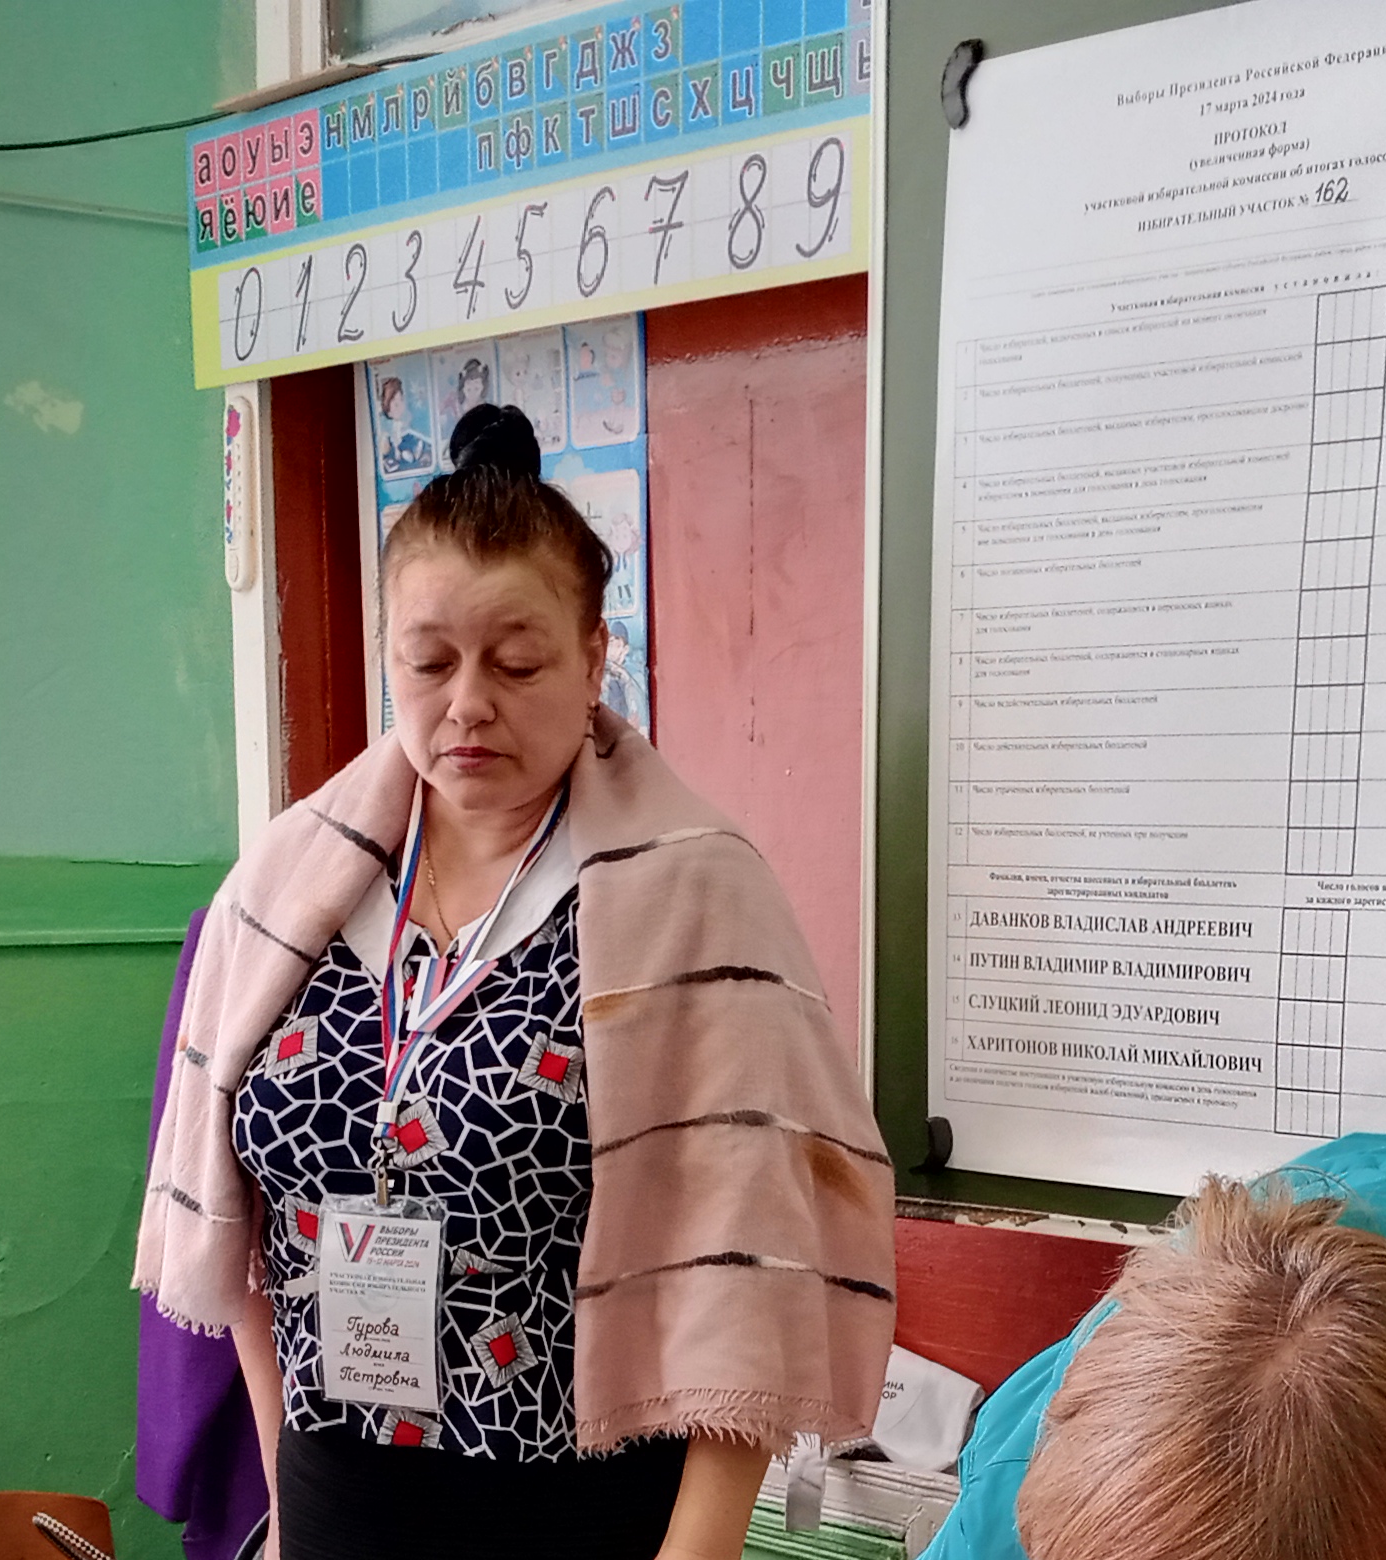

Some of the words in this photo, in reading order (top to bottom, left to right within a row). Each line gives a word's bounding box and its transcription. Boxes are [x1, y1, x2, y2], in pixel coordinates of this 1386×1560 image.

[1117, 88, 1165, 107] Выборы
[1170, 74, 1241, 97] Президента
[1246, 58, 1319, 81] Российской
[1200, 103, 1212, 116] 17
[1215, 99, 1248, 114] марта
[1252, 91, 1277, 108] 2024
[1280, 88, 1305, 102] года
[1214, 122, 1287, 146] ПРОТОКОЛ
[1138, 204, 1236, 232] ИЗБИРАТЕЛЬНЫЙ
[1240, 197, 1295, 217] УЧАСТОК
[1315, 177, 1350, 204] 162
[234, 268, 261, 361] 0
[296, 255, 311, 351] 1
[338, 244, 367, 342] 2
[392, 230, 422, 331] 3
[454, 217, 485, 318] 4
[506, 202, 547, 308] 5
[577, 188, 615, 298] 6
[645, 171, 689, 284] 7
[728, 154, 765, 269] 8
[796, 138, 844, 257] 9
[970, 911, 1050, 929] ДАВАНКОВ
[1053, 916, 1148, 933] ВЛАДИСЛАВ
[1152, 921, 1252, 938] АНДРЕЕВИЧ
[970, 953, 1020, 969] ПУТИН
[1023, 956, 1109, 975] ВЛАДИМИР
[1113, 959, 1252, 983] ВЛАДИМИРОВИЧ
[969, 993, 1040, 1013] СЛУЦКИЙ
[1043, 998, 1108, 1018] ЛЕОНИД
[1111, 1005, 1220, 1026] ЭДУАРДОВИЧ
[968, 1035, 1058, 1056] ХАРИТОНОВ
[1062, 1043, 1138, 1062] НИКОЛАЙ
[1142, 1049, 1263, 1073] МИХАЙЛОВИЧ
[375, 1237, 429, 1248] ПРЕЗИДЕНТА
[380, 1225, 419, 1235] ВЫБОРЫ
[370, 1247, 404, 1257] РОССИИ
[347, 1316, 400, 1341] Гурова
[340, 1343, 410, 1362] Людмила
[340, 1366, 420, 1389] Петровна
